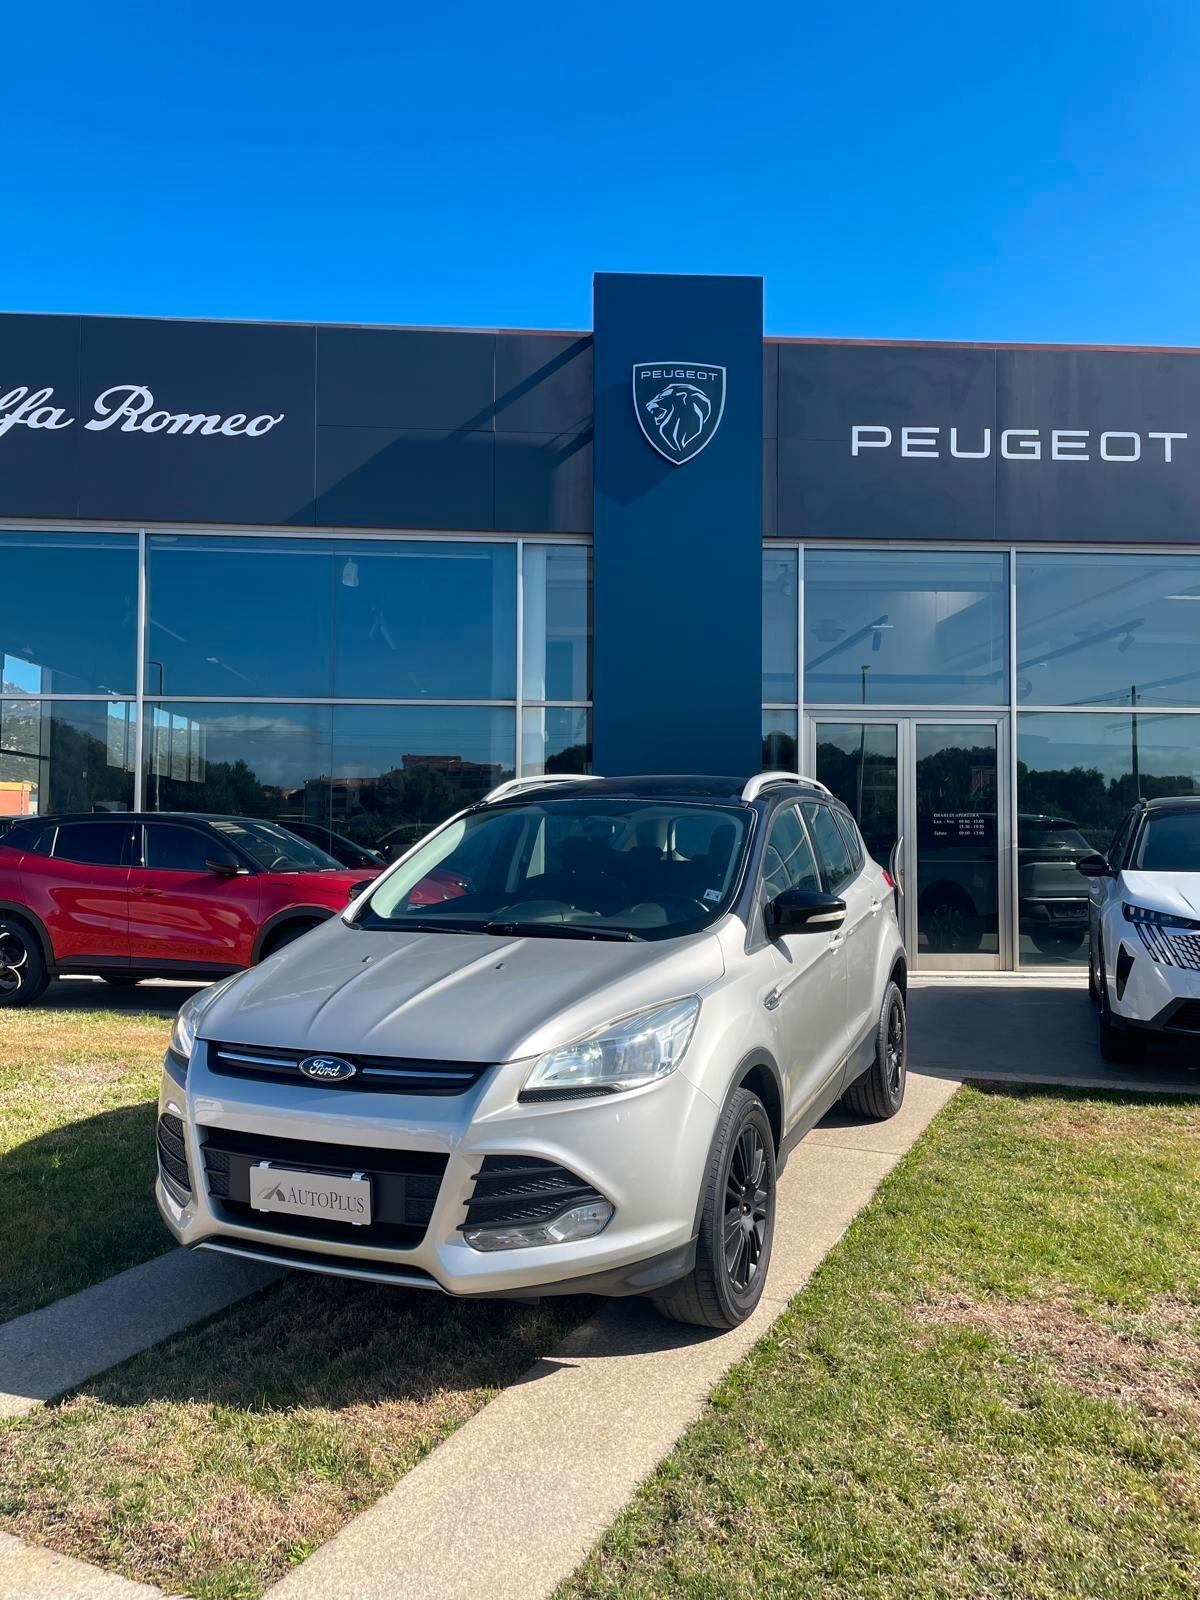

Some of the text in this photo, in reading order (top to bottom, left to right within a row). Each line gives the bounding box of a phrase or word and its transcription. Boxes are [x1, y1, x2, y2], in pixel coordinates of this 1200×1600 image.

[641, 370, 718, 380] PEUGEOT
[0, 385, 284, 436] lfa Romeo
[852, 426, 1187, 462] PEUGEOT
[309, 1059, 341, 1077] Ford
